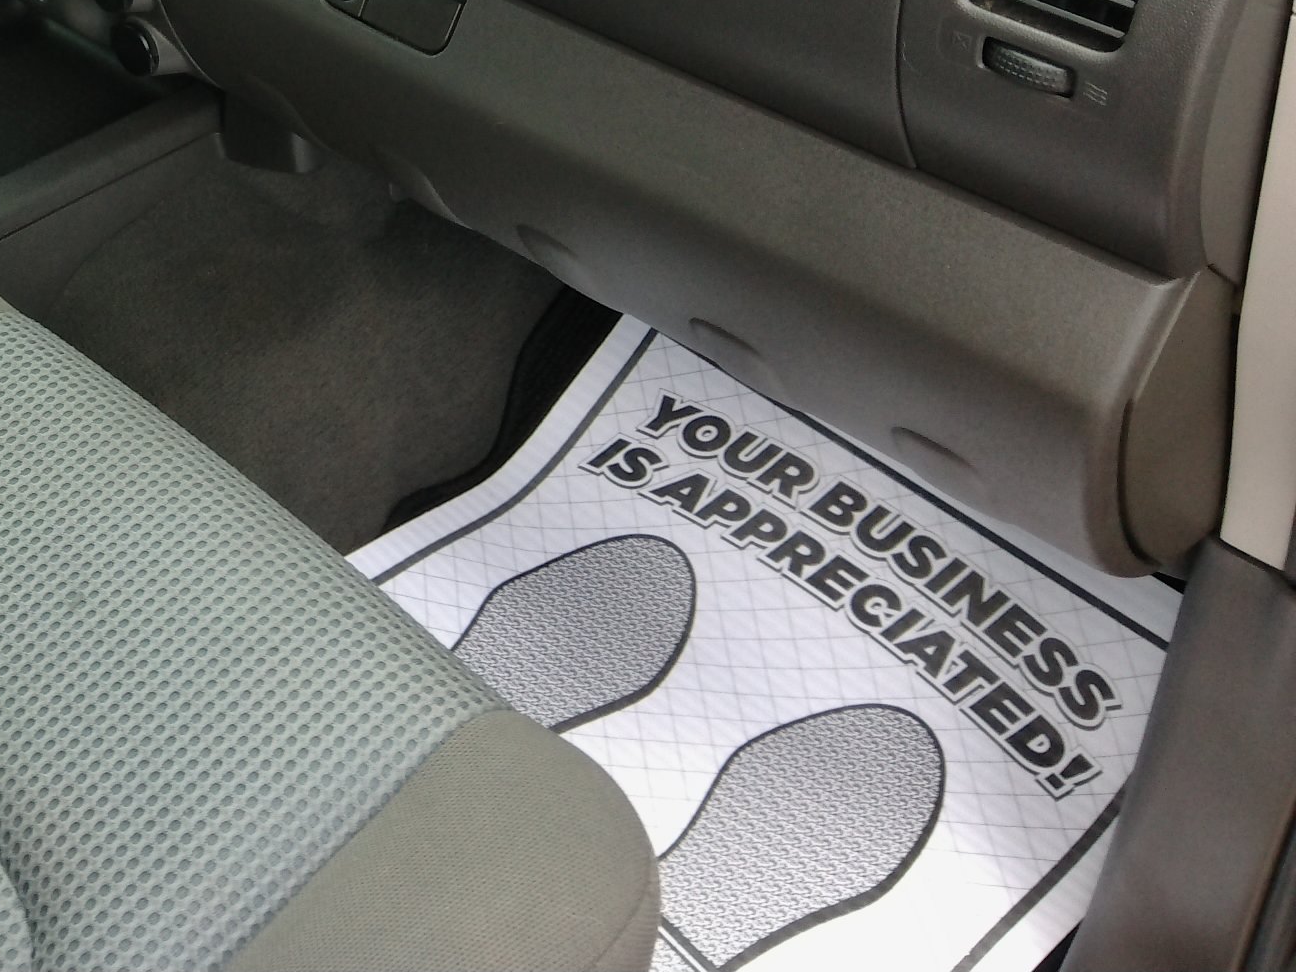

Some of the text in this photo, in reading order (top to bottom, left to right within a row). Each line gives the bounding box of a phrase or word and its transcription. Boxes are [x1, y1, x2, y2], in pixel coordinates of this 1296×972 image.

[582, 435, 1099, 797] IS APPRECIATED!
[639, 391, 1120, 729] YOUR BUSINESS
